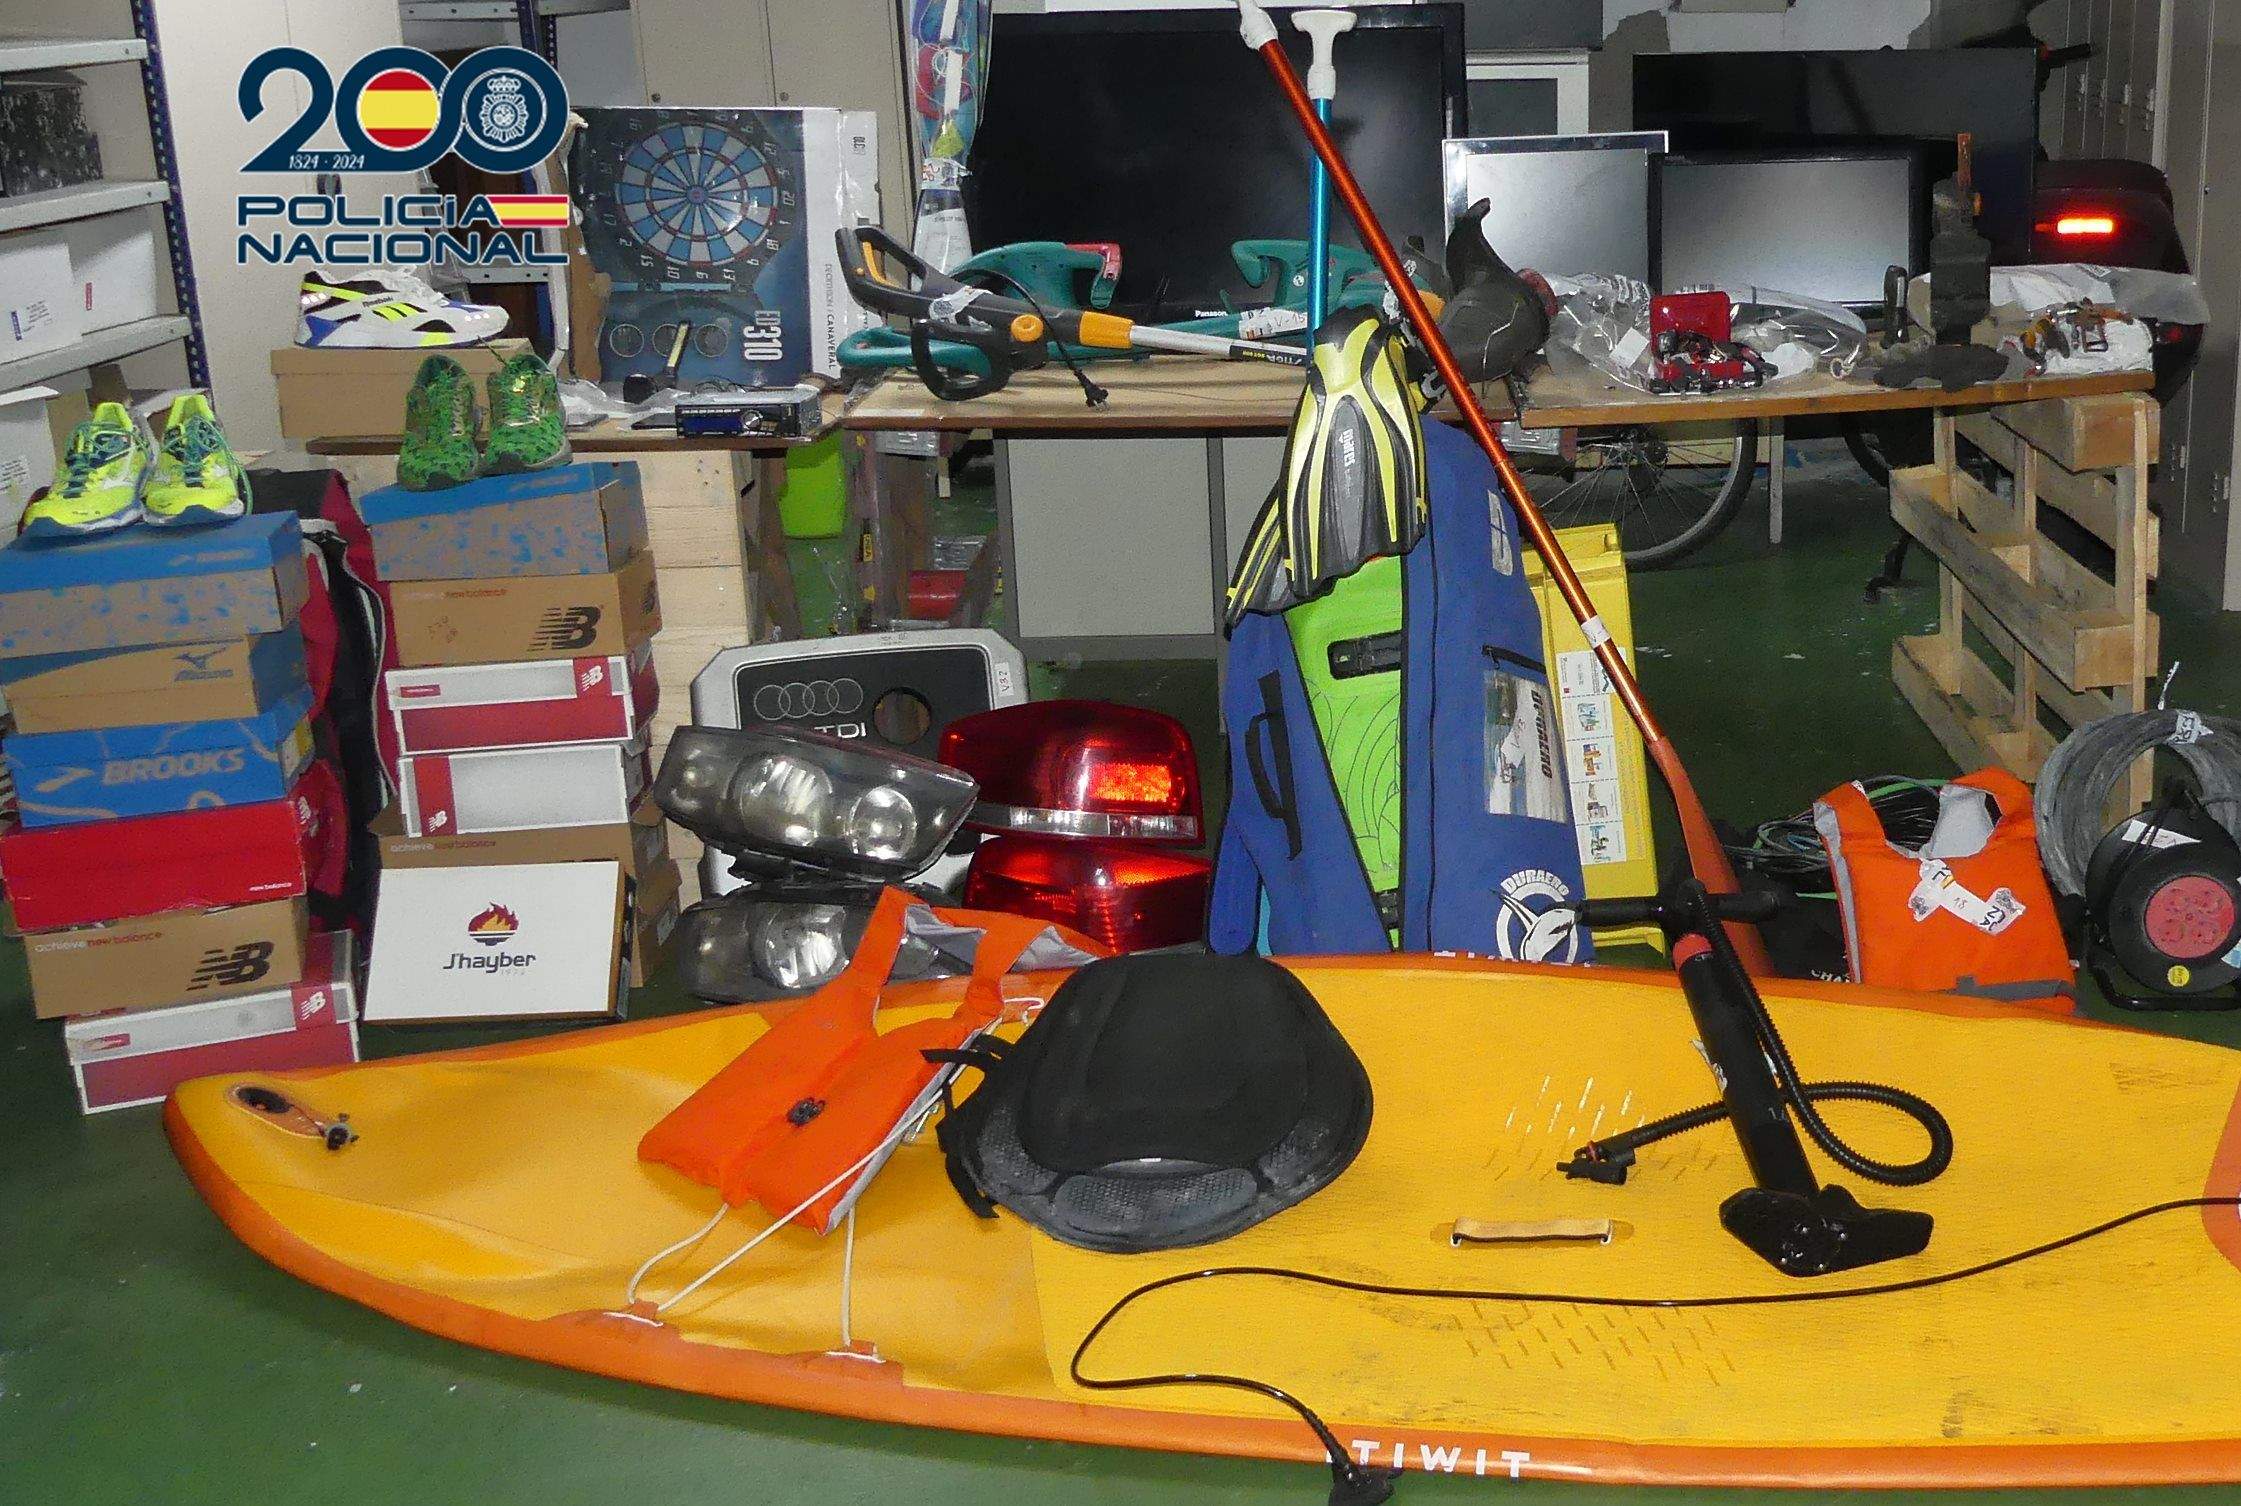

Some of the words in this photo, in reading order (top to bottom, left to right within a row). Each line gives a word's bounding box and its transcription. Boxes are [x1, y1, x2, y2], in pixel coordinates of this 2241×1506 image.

[782, 190, 796, 206] 20
[742, 310, 784, 361] ED310
[826, 313, 837, 370] CANAVERAL
[814, 722, 866, 738] TDI
[103, 749, 245, 786] BROOKS
[1500, 869, 1570, 896] DURAERO
[1326, 1439, 1530, 1478] TIWIT
